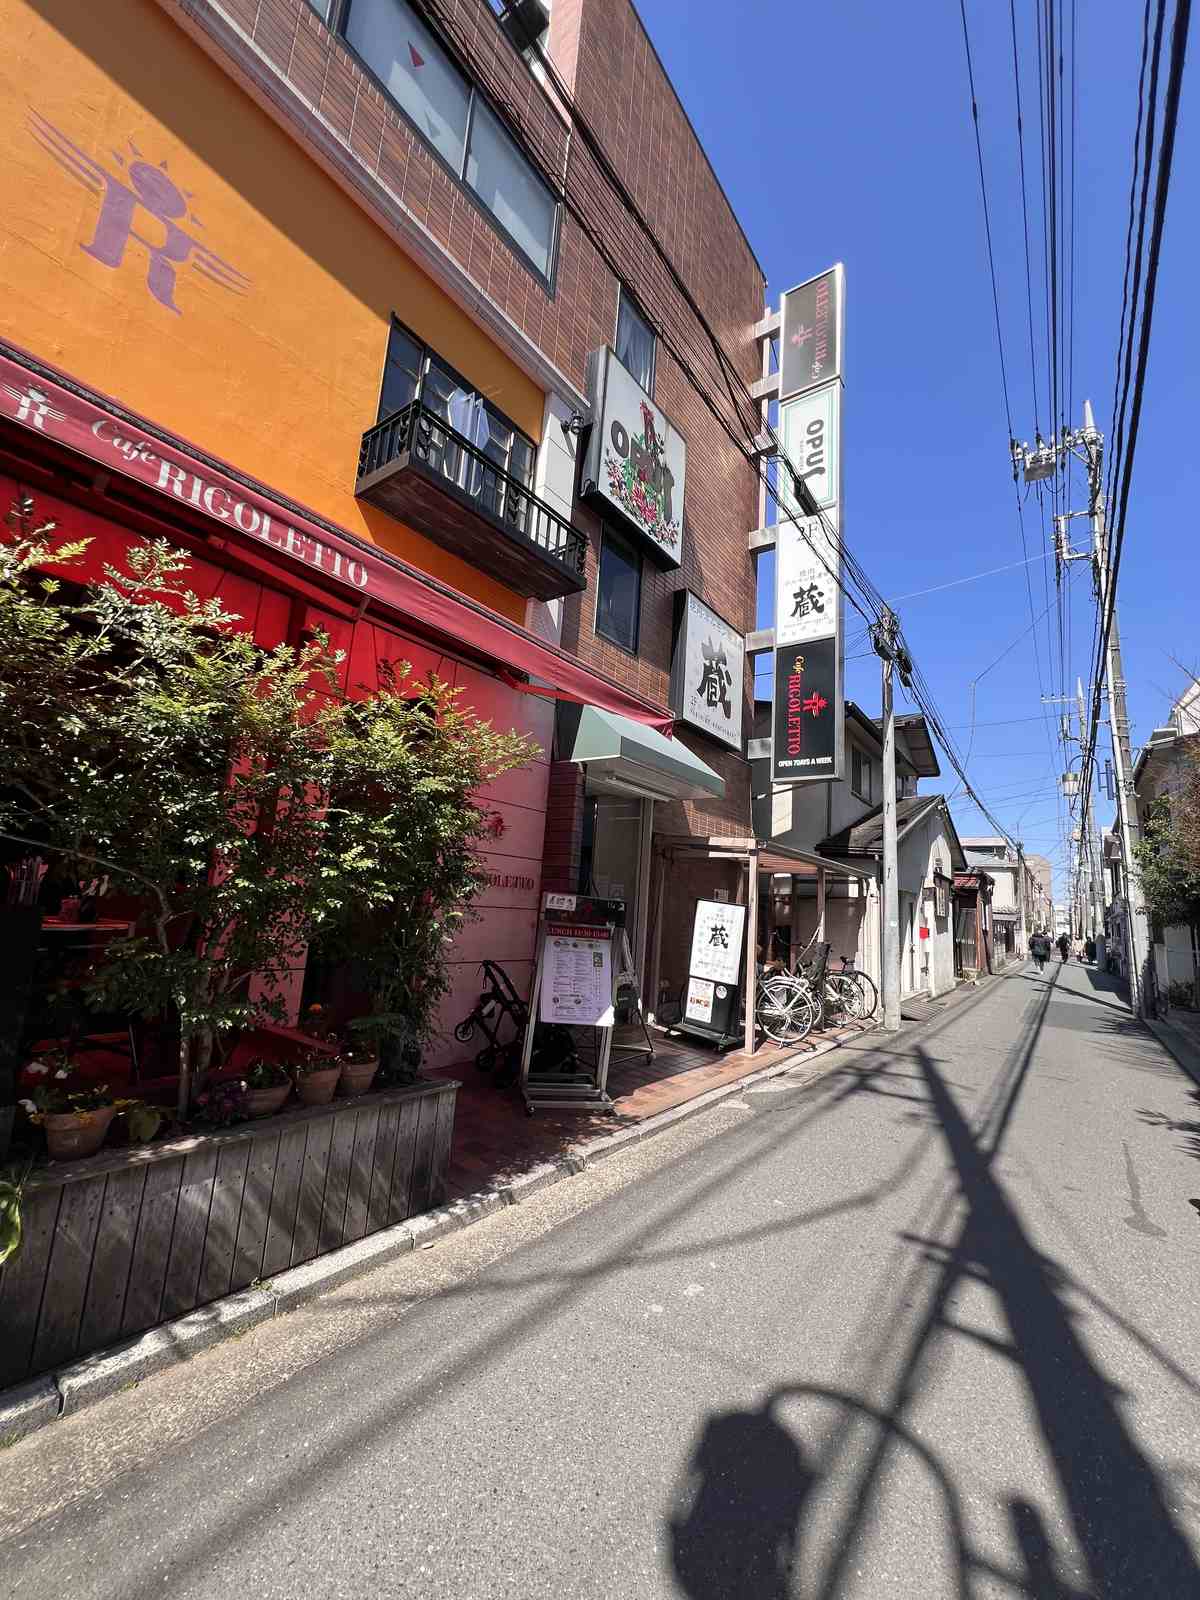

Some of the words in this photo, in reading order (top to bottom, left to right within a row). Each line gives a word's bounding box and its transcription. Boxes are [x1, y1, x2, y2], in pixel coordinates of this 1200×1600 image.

[155, 456, 369, 588] RIGOLETTO
[790, 582, 825, 618] 蔵
[696, 635, 733, 720] 蔵
[787, 674, 801, 757] RIGOLETTO
[778, 759, 793, 768] OPEN
[810, 757, 816, 766] A
[816, 756, 833, 765] WEEK
[709, 924, 729, 949] 蔵
